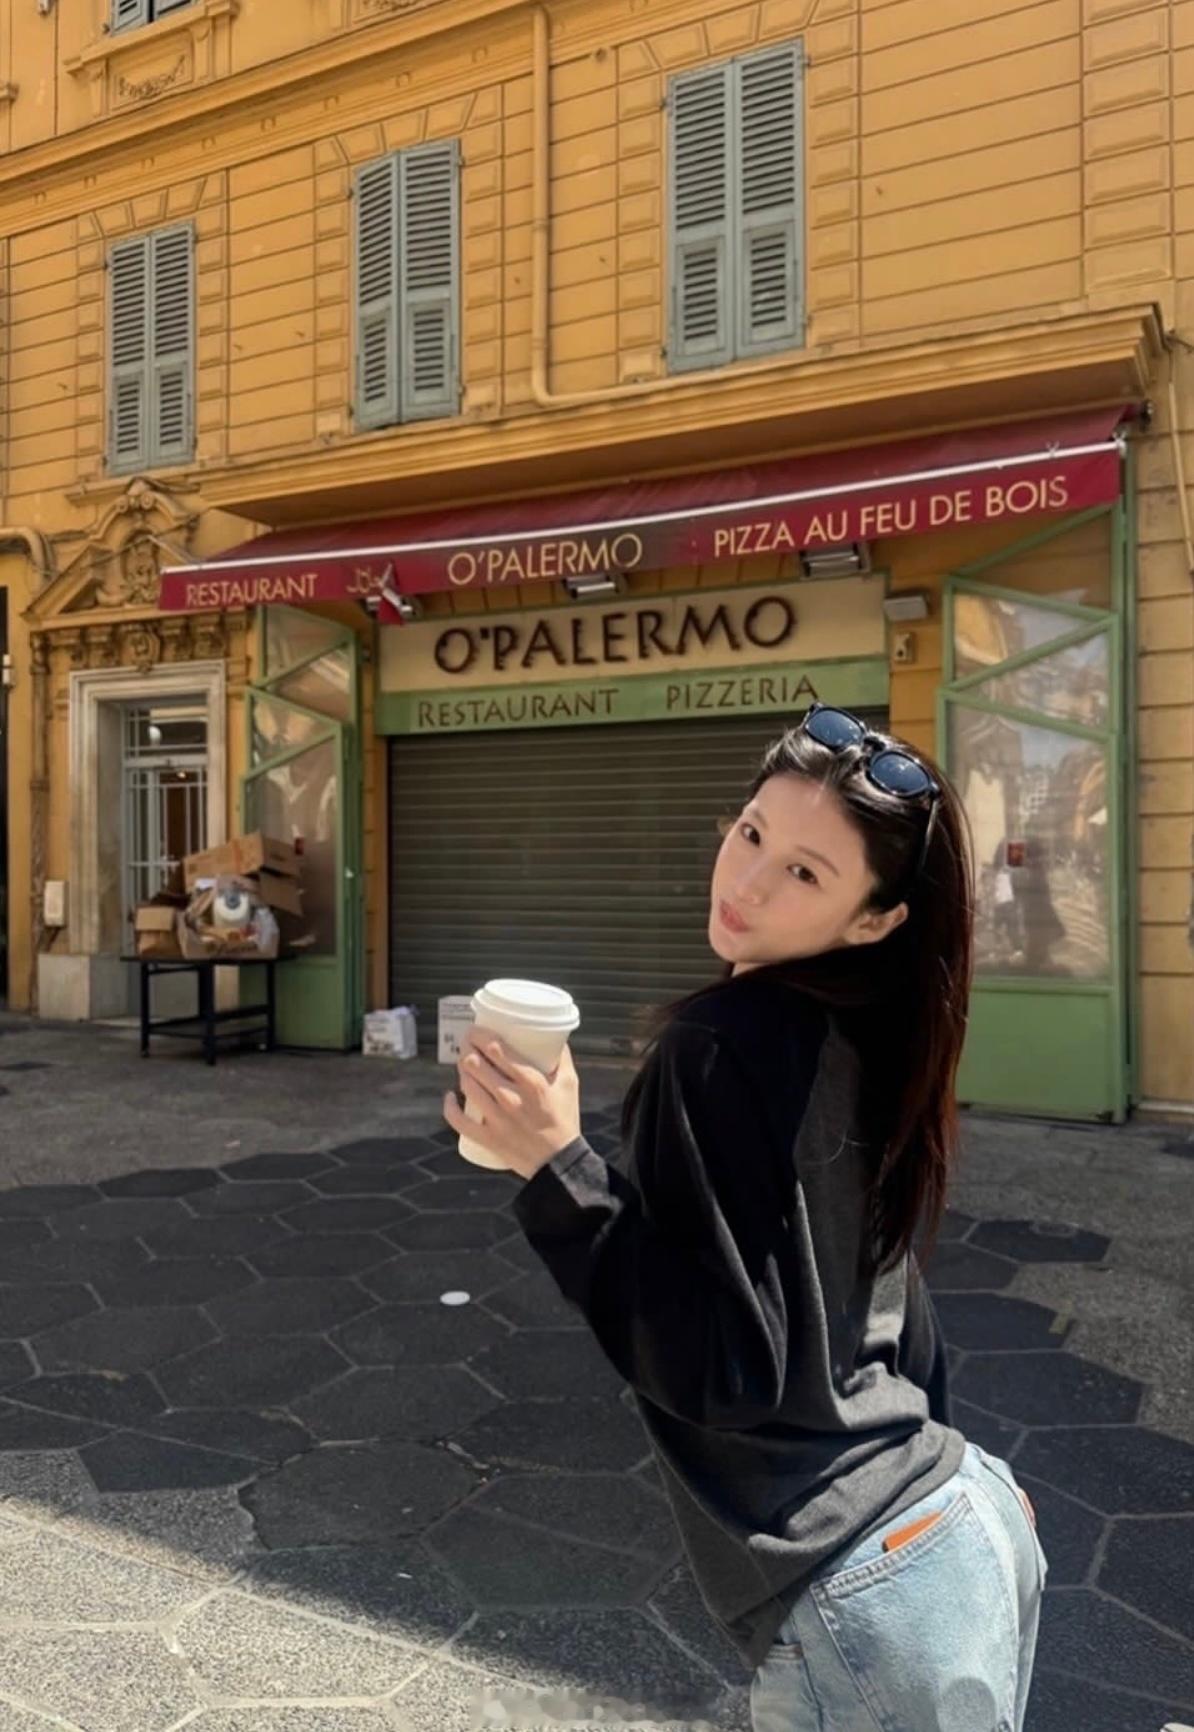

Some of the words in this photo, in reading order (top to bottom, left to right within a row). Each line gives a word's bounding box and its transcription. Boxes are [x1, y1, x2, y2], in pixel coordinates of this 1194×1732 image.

[714, 520, 794, 557] PIZZA
[804, 511, 848, 545] AU
[860, 499, 917, 535] FEU
[929, 490, 972, 526] DE
[985, 476, 1068, 517] BOIS
[448, 533, 642, 585] O'PALERMO
[186, 573, 318, 606] RESTAURANT
[434, 595, 795, 674] O'PALERMO
[417, 688, 620, 728] RESTAURANT
[666, 675, 819, 711] PIZZERIA
